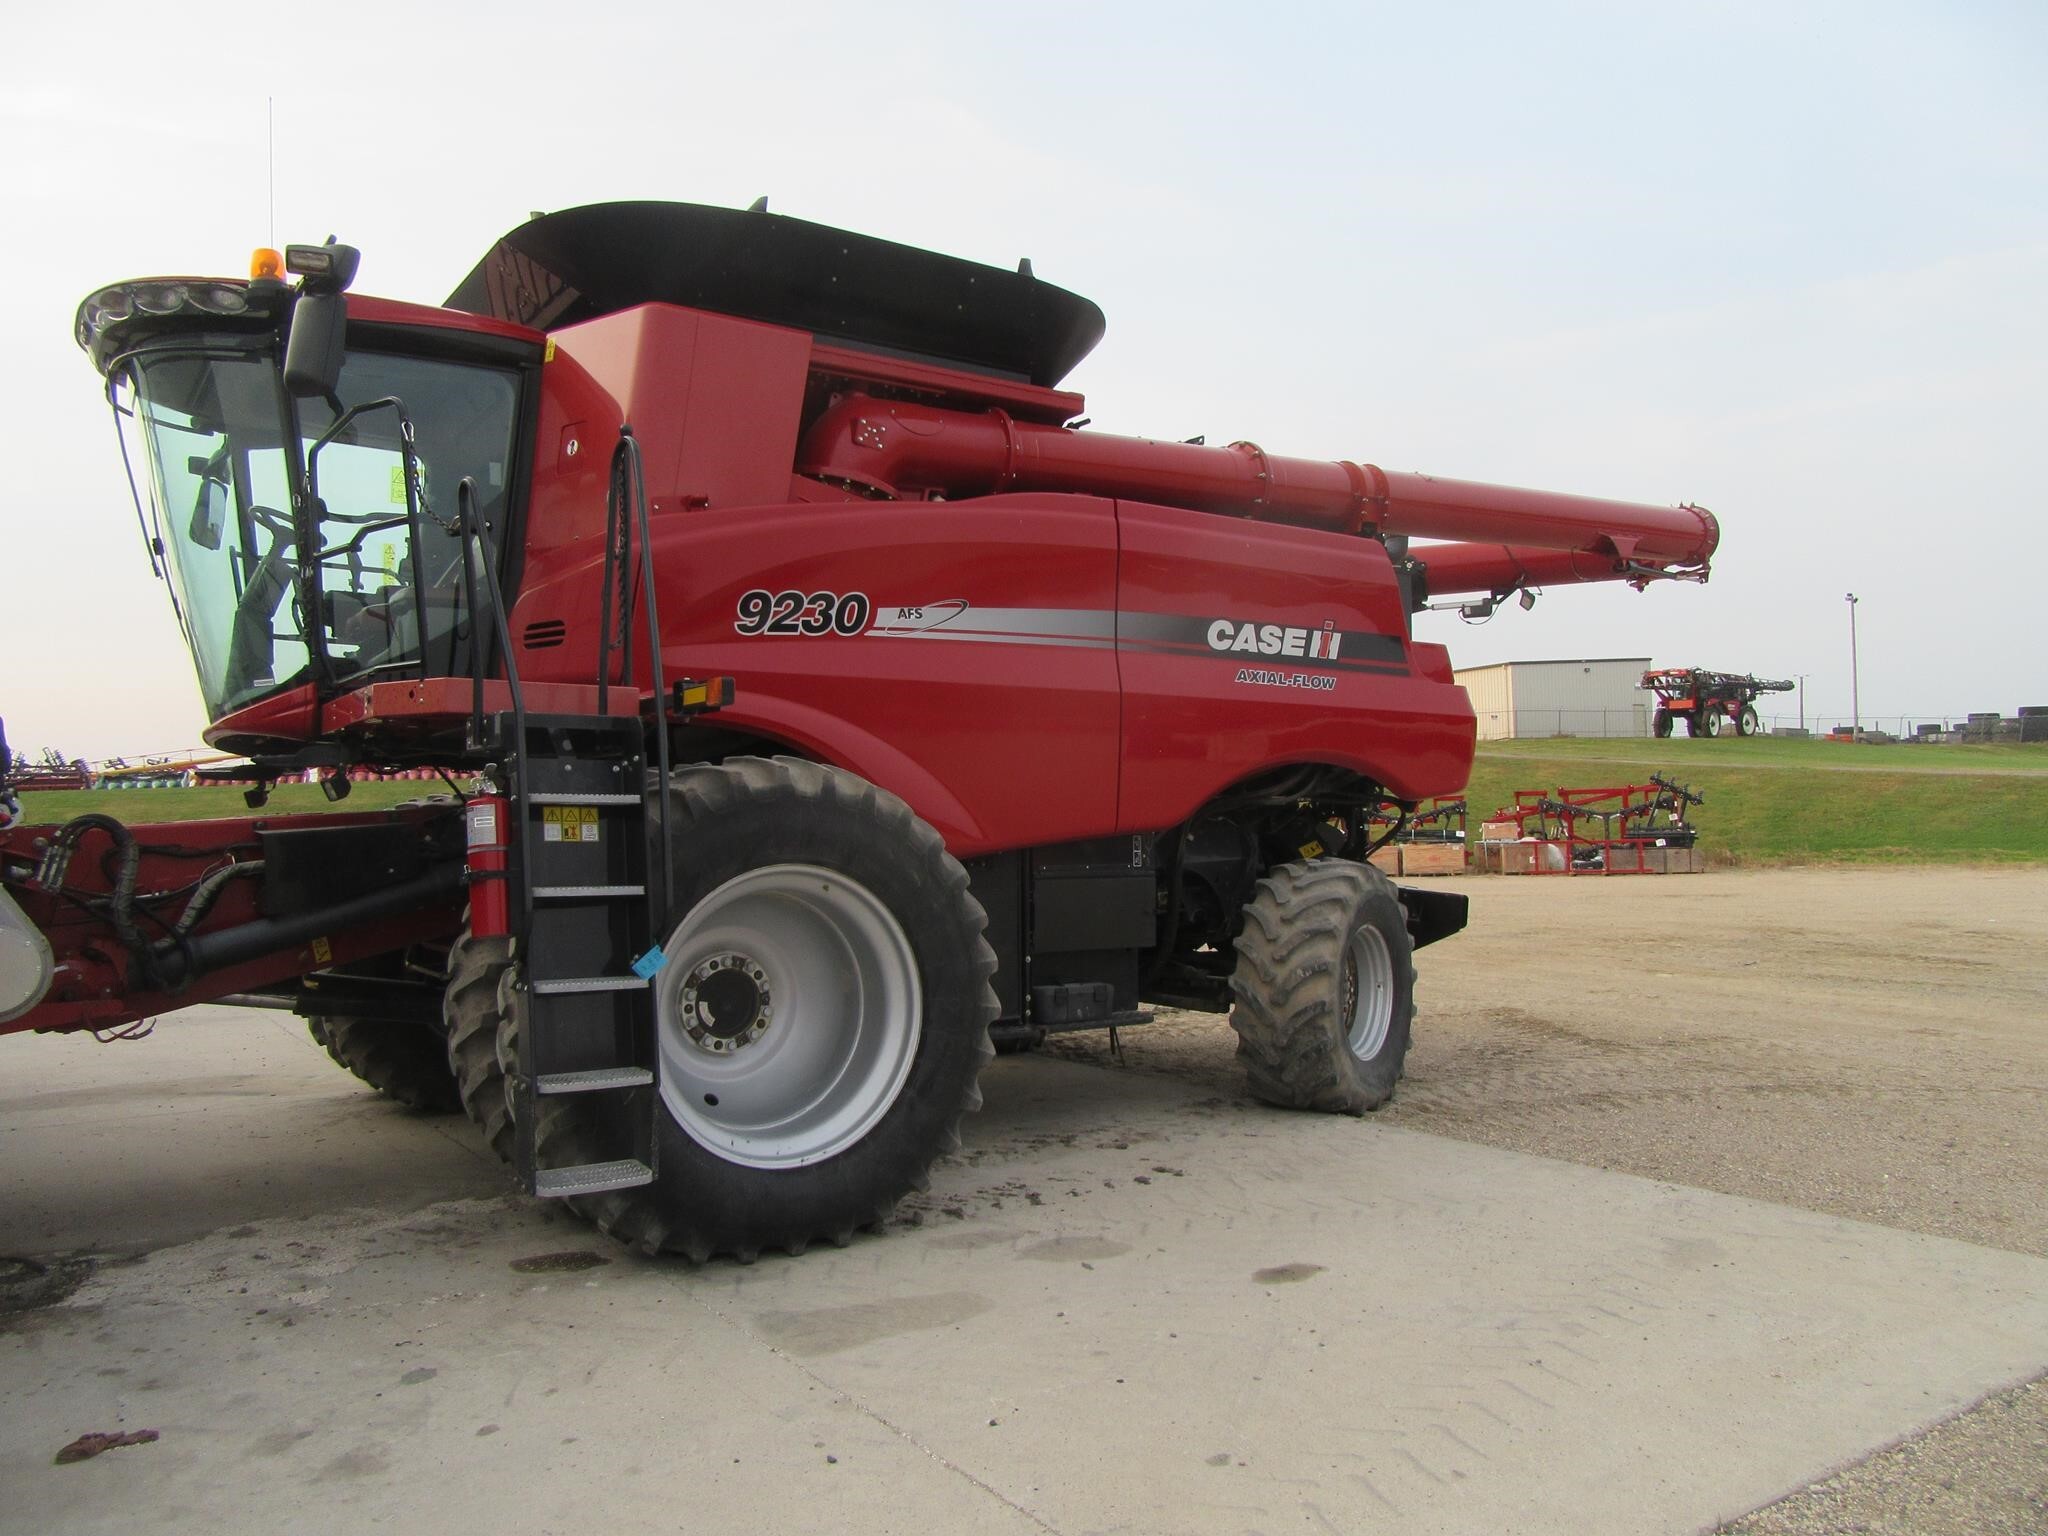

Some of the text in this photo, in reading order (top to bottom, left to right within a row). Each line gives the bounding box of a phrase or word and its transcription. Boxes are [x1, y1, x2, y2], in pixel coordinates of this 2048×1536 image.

[734, 589, 870, 636] 9230
[897, 608, 923, 620] AFS
[1207, 619, 1307, 657] CASE
[1235, 668, 1336, 690] AXIAL-FLOW
